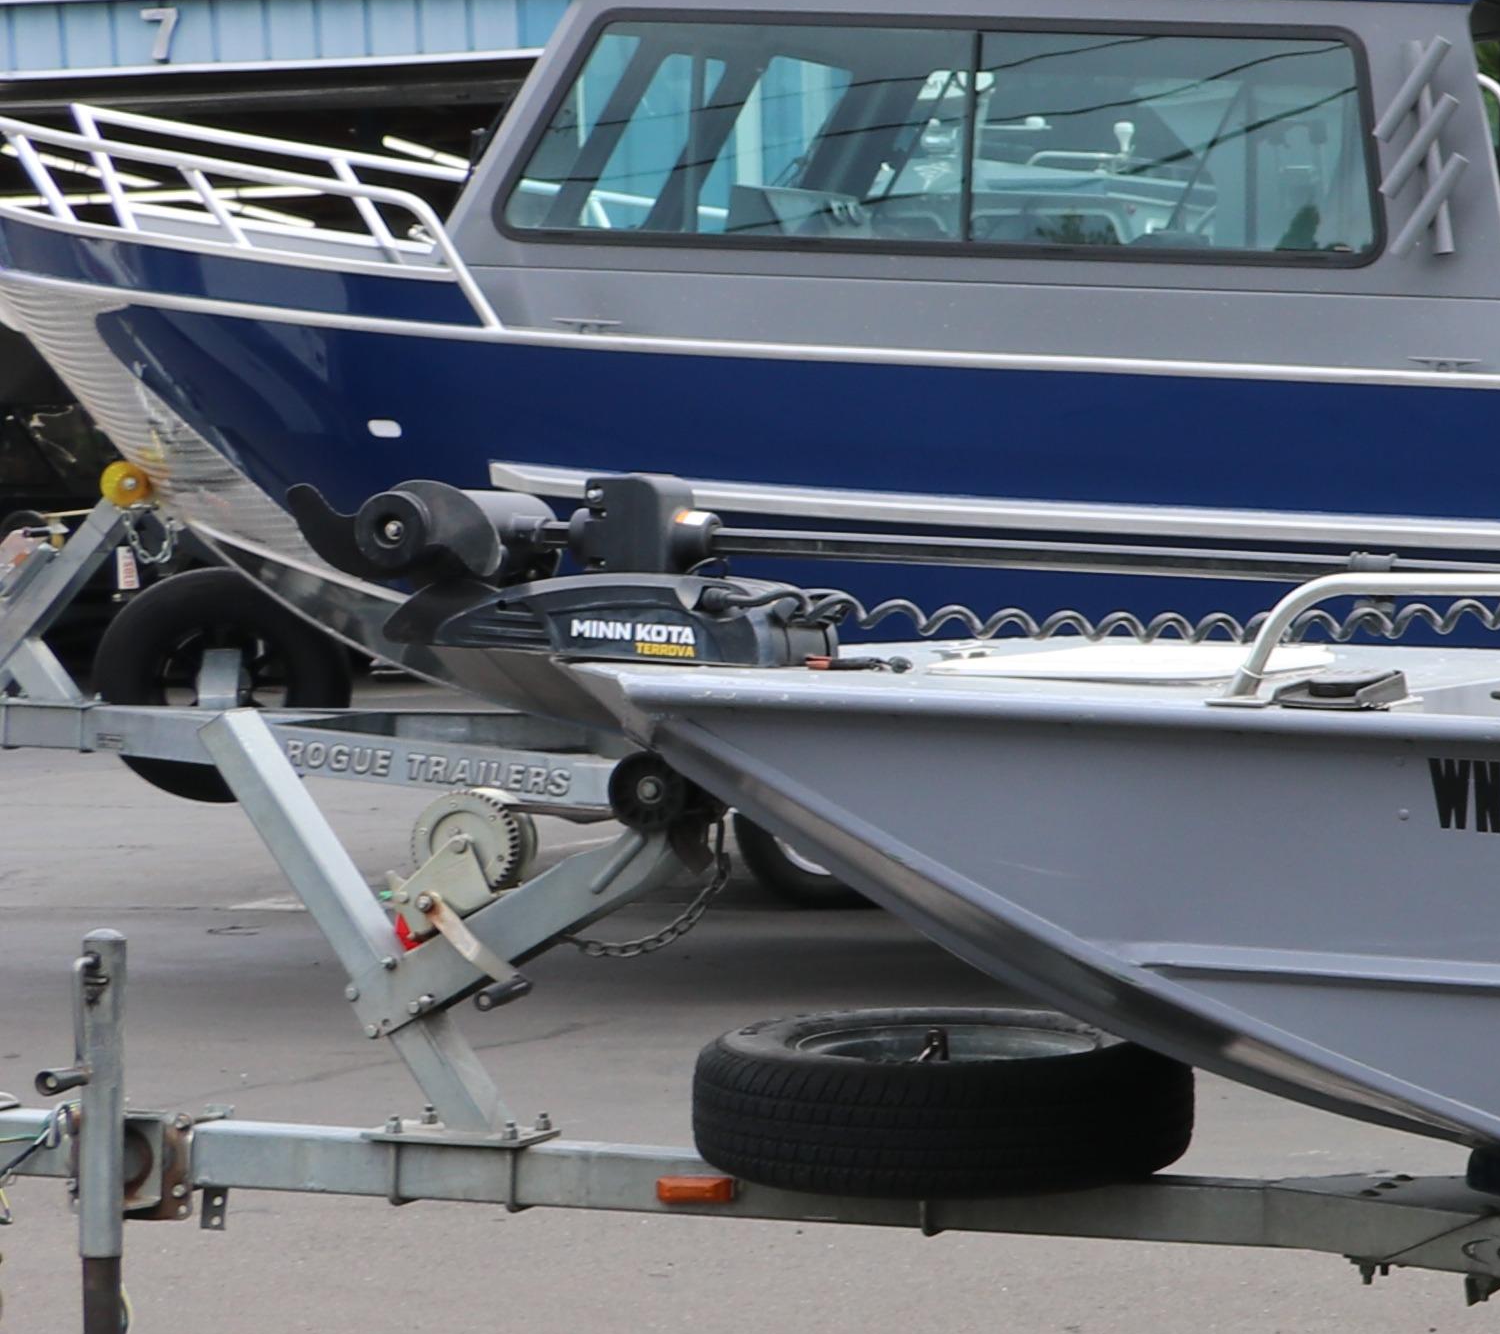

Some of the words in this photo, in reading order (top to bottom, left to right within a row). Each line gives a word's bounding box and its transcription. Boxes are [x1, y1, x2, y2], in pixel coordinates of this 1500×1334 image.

[140, 7, 179, 64] 7
[571, 619, 631, 642] MINN
[633, 623, 695, 645] KOTA
[635, 641, 695, 657] TERROVA
[286, 739, 392, 776] ROGUE
[406, 753, 572, 797] TRAILERS
